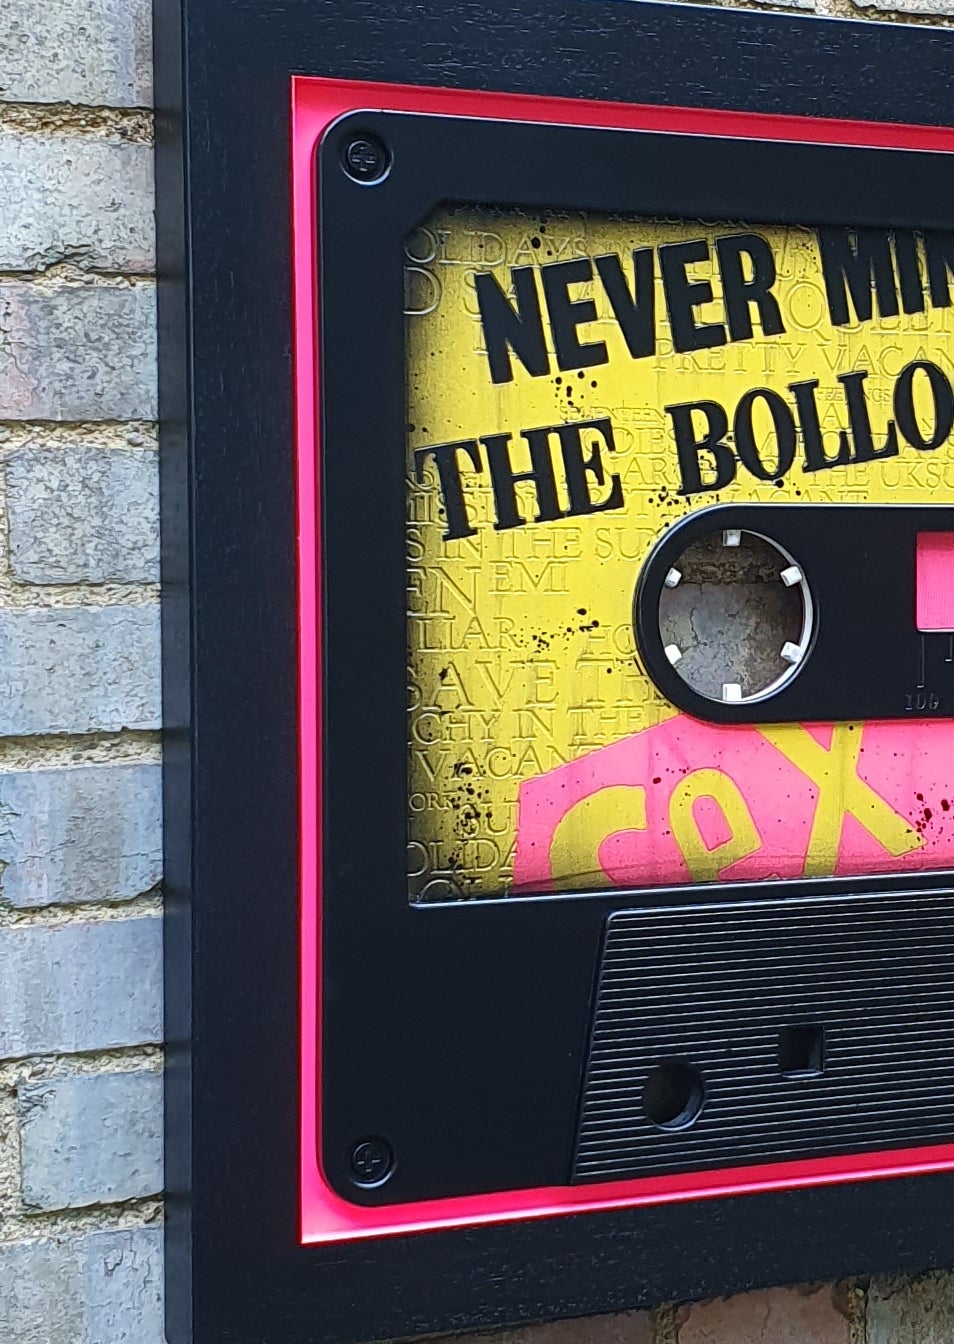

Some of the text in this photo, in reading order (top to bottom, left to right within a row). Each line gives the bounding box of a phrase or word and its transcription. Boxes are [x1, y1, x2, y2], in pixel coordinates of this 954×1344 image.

[474, 233, 786, 385] NEVER
[414, 416, 625, 542] THE
[495, 526, 583, 562] THE
[488, 559, 571, 595] EMI
[415, 615, 522, 652] LIAR
